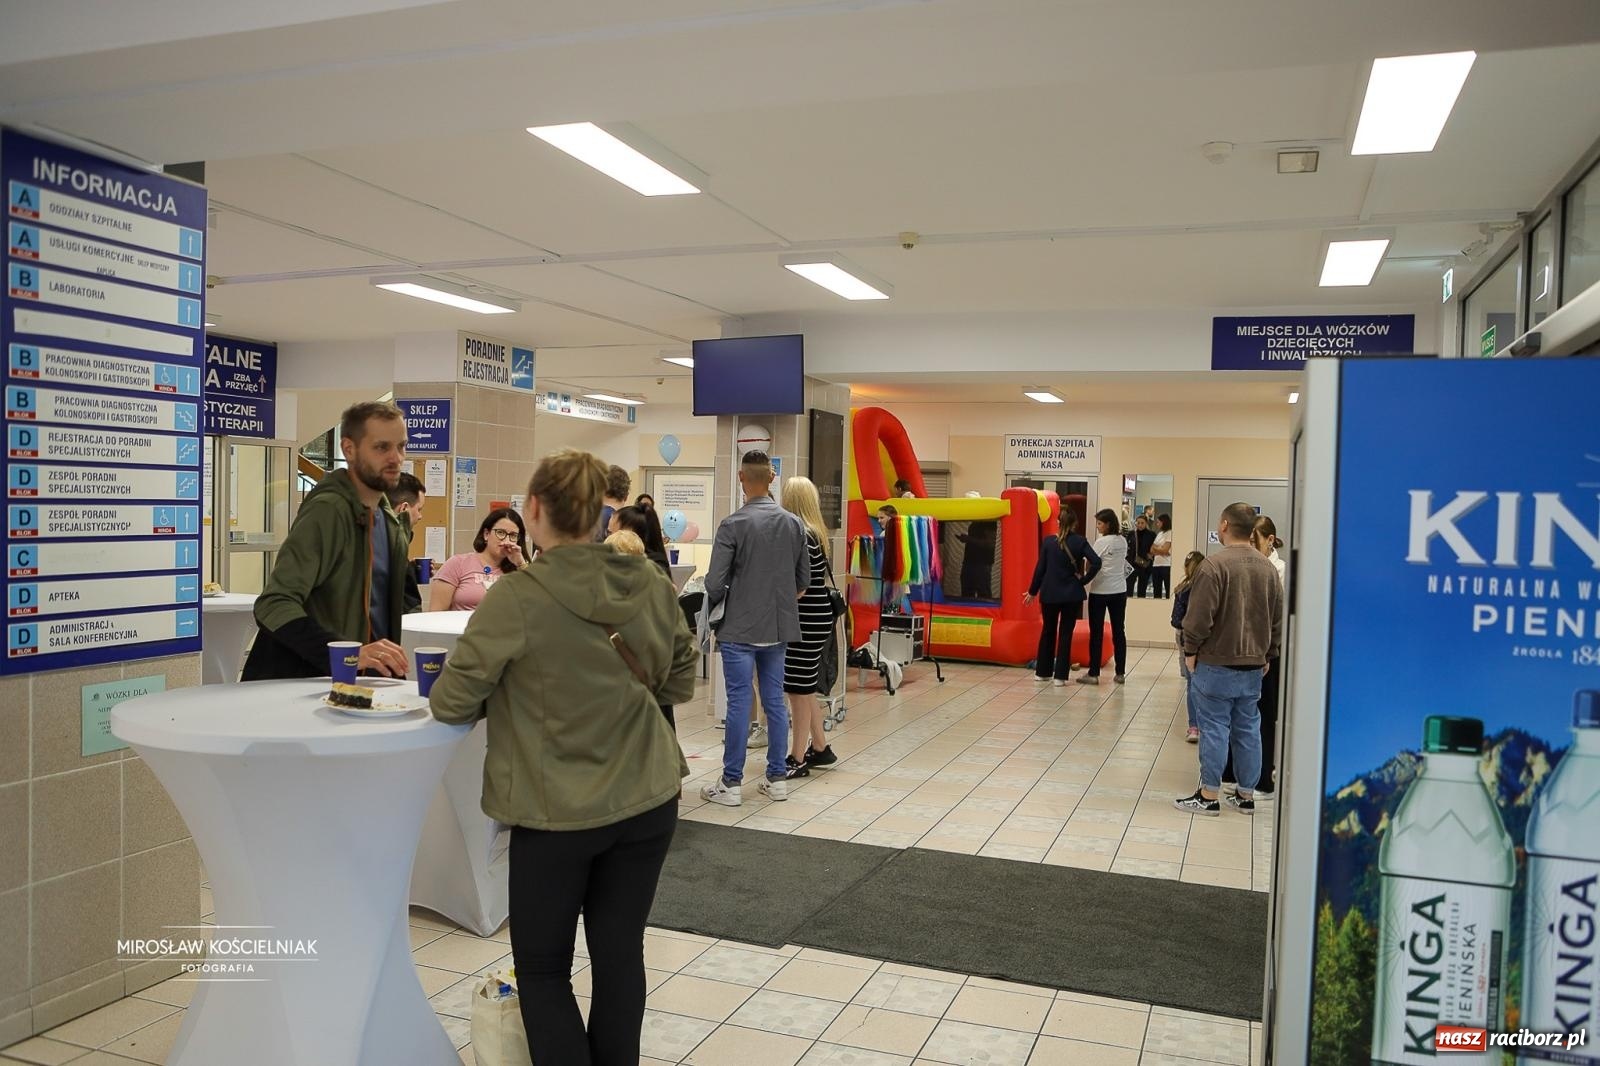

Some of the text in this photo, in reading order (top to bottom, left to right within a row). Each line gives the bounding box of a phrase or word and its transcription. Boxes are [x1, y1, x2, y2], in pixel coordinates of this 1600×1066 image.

[33, 157, 178, 216] INFORMACJA
[18, 189, 32, 206] A
[49, 203, 133, 232] ODDZIAŁY SZPITALNE
[18, 230, 32, 247] A
[49, 237, 81, 252] USŁUGI
[82, 245, 135, 265] KOMERCYJNE
[19, 270, 32, 287] B
[49, 281, 106, 300] LABORATORIA
[1237, 323, 1390, 336] MIEJSCE DLA WÓZKÓW
[465, 338, 506, 363] PORADNIE
[1267, 337, 1354, 351] DZIECIĘCYCH
[19, 350, 32, 366] B
[1261, 350, 1265, 361] I
[45, 353, 150, 375] PRACOWNIA DIAGNOSTYCZNA
[45, 367, 98, 381] KOLONOSKOPII
[102, 373, 150, 387] GASTROSKOPII
[233, 373, 251, 383] IZBA
[463, 360, 509, 385] REJESTRACJA
[225, 380, 259, 393] PRZYJĘĆ
[16, 392, 29, 408] B
[54, 396, 158, 413] PRACOWNIA DIAGNOSTYCZNA
[54, 410, 105, 422] KOLONOSKOPII
[111, 414, 158, 426] GASTROSKOPII
[410, 405, 438, 415] SKLEP
[217, 416, 264, 432] TERAPII
[19, 431, 32, 447] D
[48, 432, 152, 448] REJESTRACJA DO PORADNI
[1010, 438, 1095, 448] DYREKCJA SZPITALA
[48, 445, 131, 459] SPECJALISTYCZNYCH
[1017, 449, 1086, 459] ADMINISTRACJA
[1040, 460, 1063, 469] KASA
[19, 469, 31, 486] D
[81, 472, 117, 482] PORADNI
[48, 484, 131, 495] SPECJALISTYCZNYCH
[19, 509, 31, 526] D
[81, 510, 117, 519] PORADNI
[17, 550, 30, 567] C
[1427, 574, 1560, 599] NATURALNA
[19, 588, 31, 604] D
[49, 591, 80, 602] APTEKA
[19, 628, 31, 645] D
[49, 630, 138, 648] SALA KONFERENCYJNA
[105, 688, 148, 700] WÓZKI DLA
